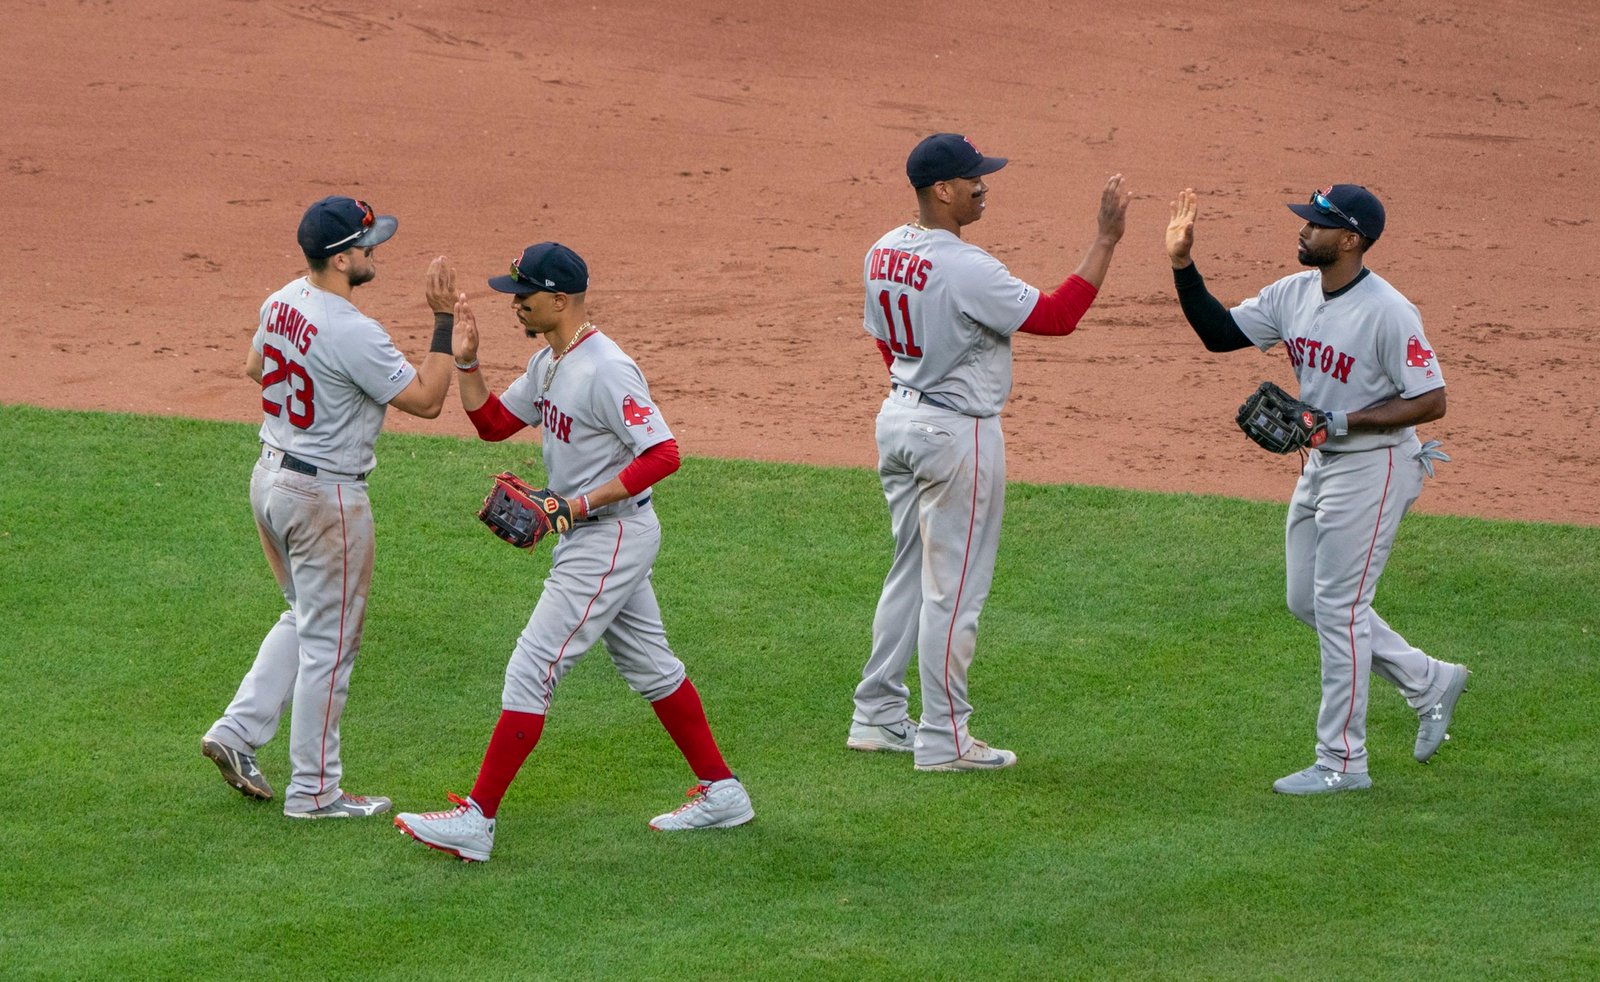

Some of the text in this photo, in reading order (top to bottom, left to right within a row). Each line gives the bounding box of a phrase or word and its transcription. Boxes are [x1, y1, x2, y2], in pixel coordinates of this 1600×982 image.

[869, 248, 933, 292] DEVERS
[266, 300, 318, 356] CHAVIS
[879, 289, 923, 358] 11
[262, 342, 315, 430] 23
